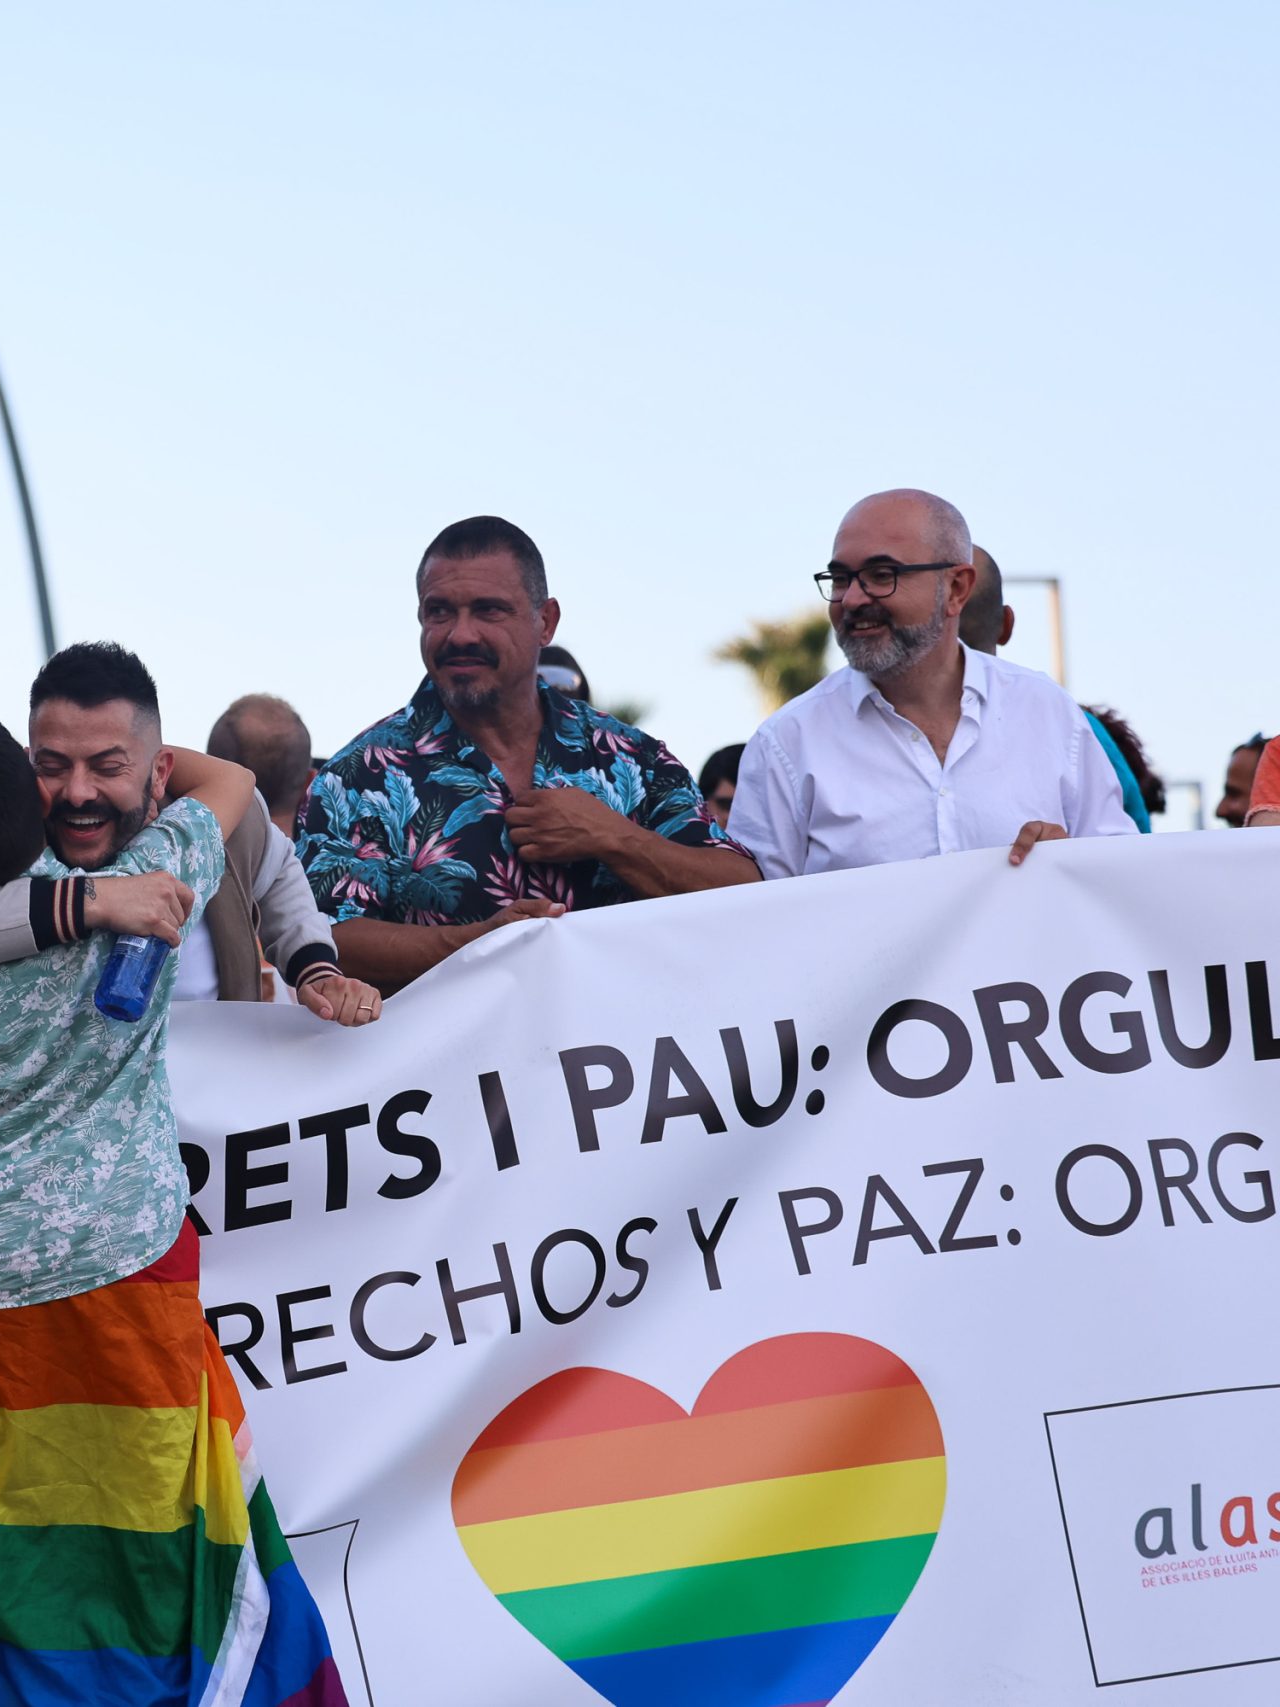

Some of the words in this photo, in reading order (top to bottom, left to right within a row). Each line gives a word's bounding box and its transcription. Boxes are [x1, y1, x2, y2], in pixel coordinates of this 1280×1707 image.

[478, 1071, 520, 1171] I
[559, 1019, 829, 1152] PAU:
[867, 961, 1280, 1098] ORGUL
[687, 1197, 738, 1290] Y
[779, 1158, 1022, 1275] PAZ:
[1056, 1132, 1276, 1236] ORG
[1142, 1576, 1157, 1588] DE
[1160, 1573, 1181, 1586] LES
[1182, 1569, 1211, 1583] ILLES
[1213, 1563, 1259, 1578] BALEARS
[1208, 1555, 1222, 1567] DE
[1224, 1550, 1257, 1565] LLUITA
